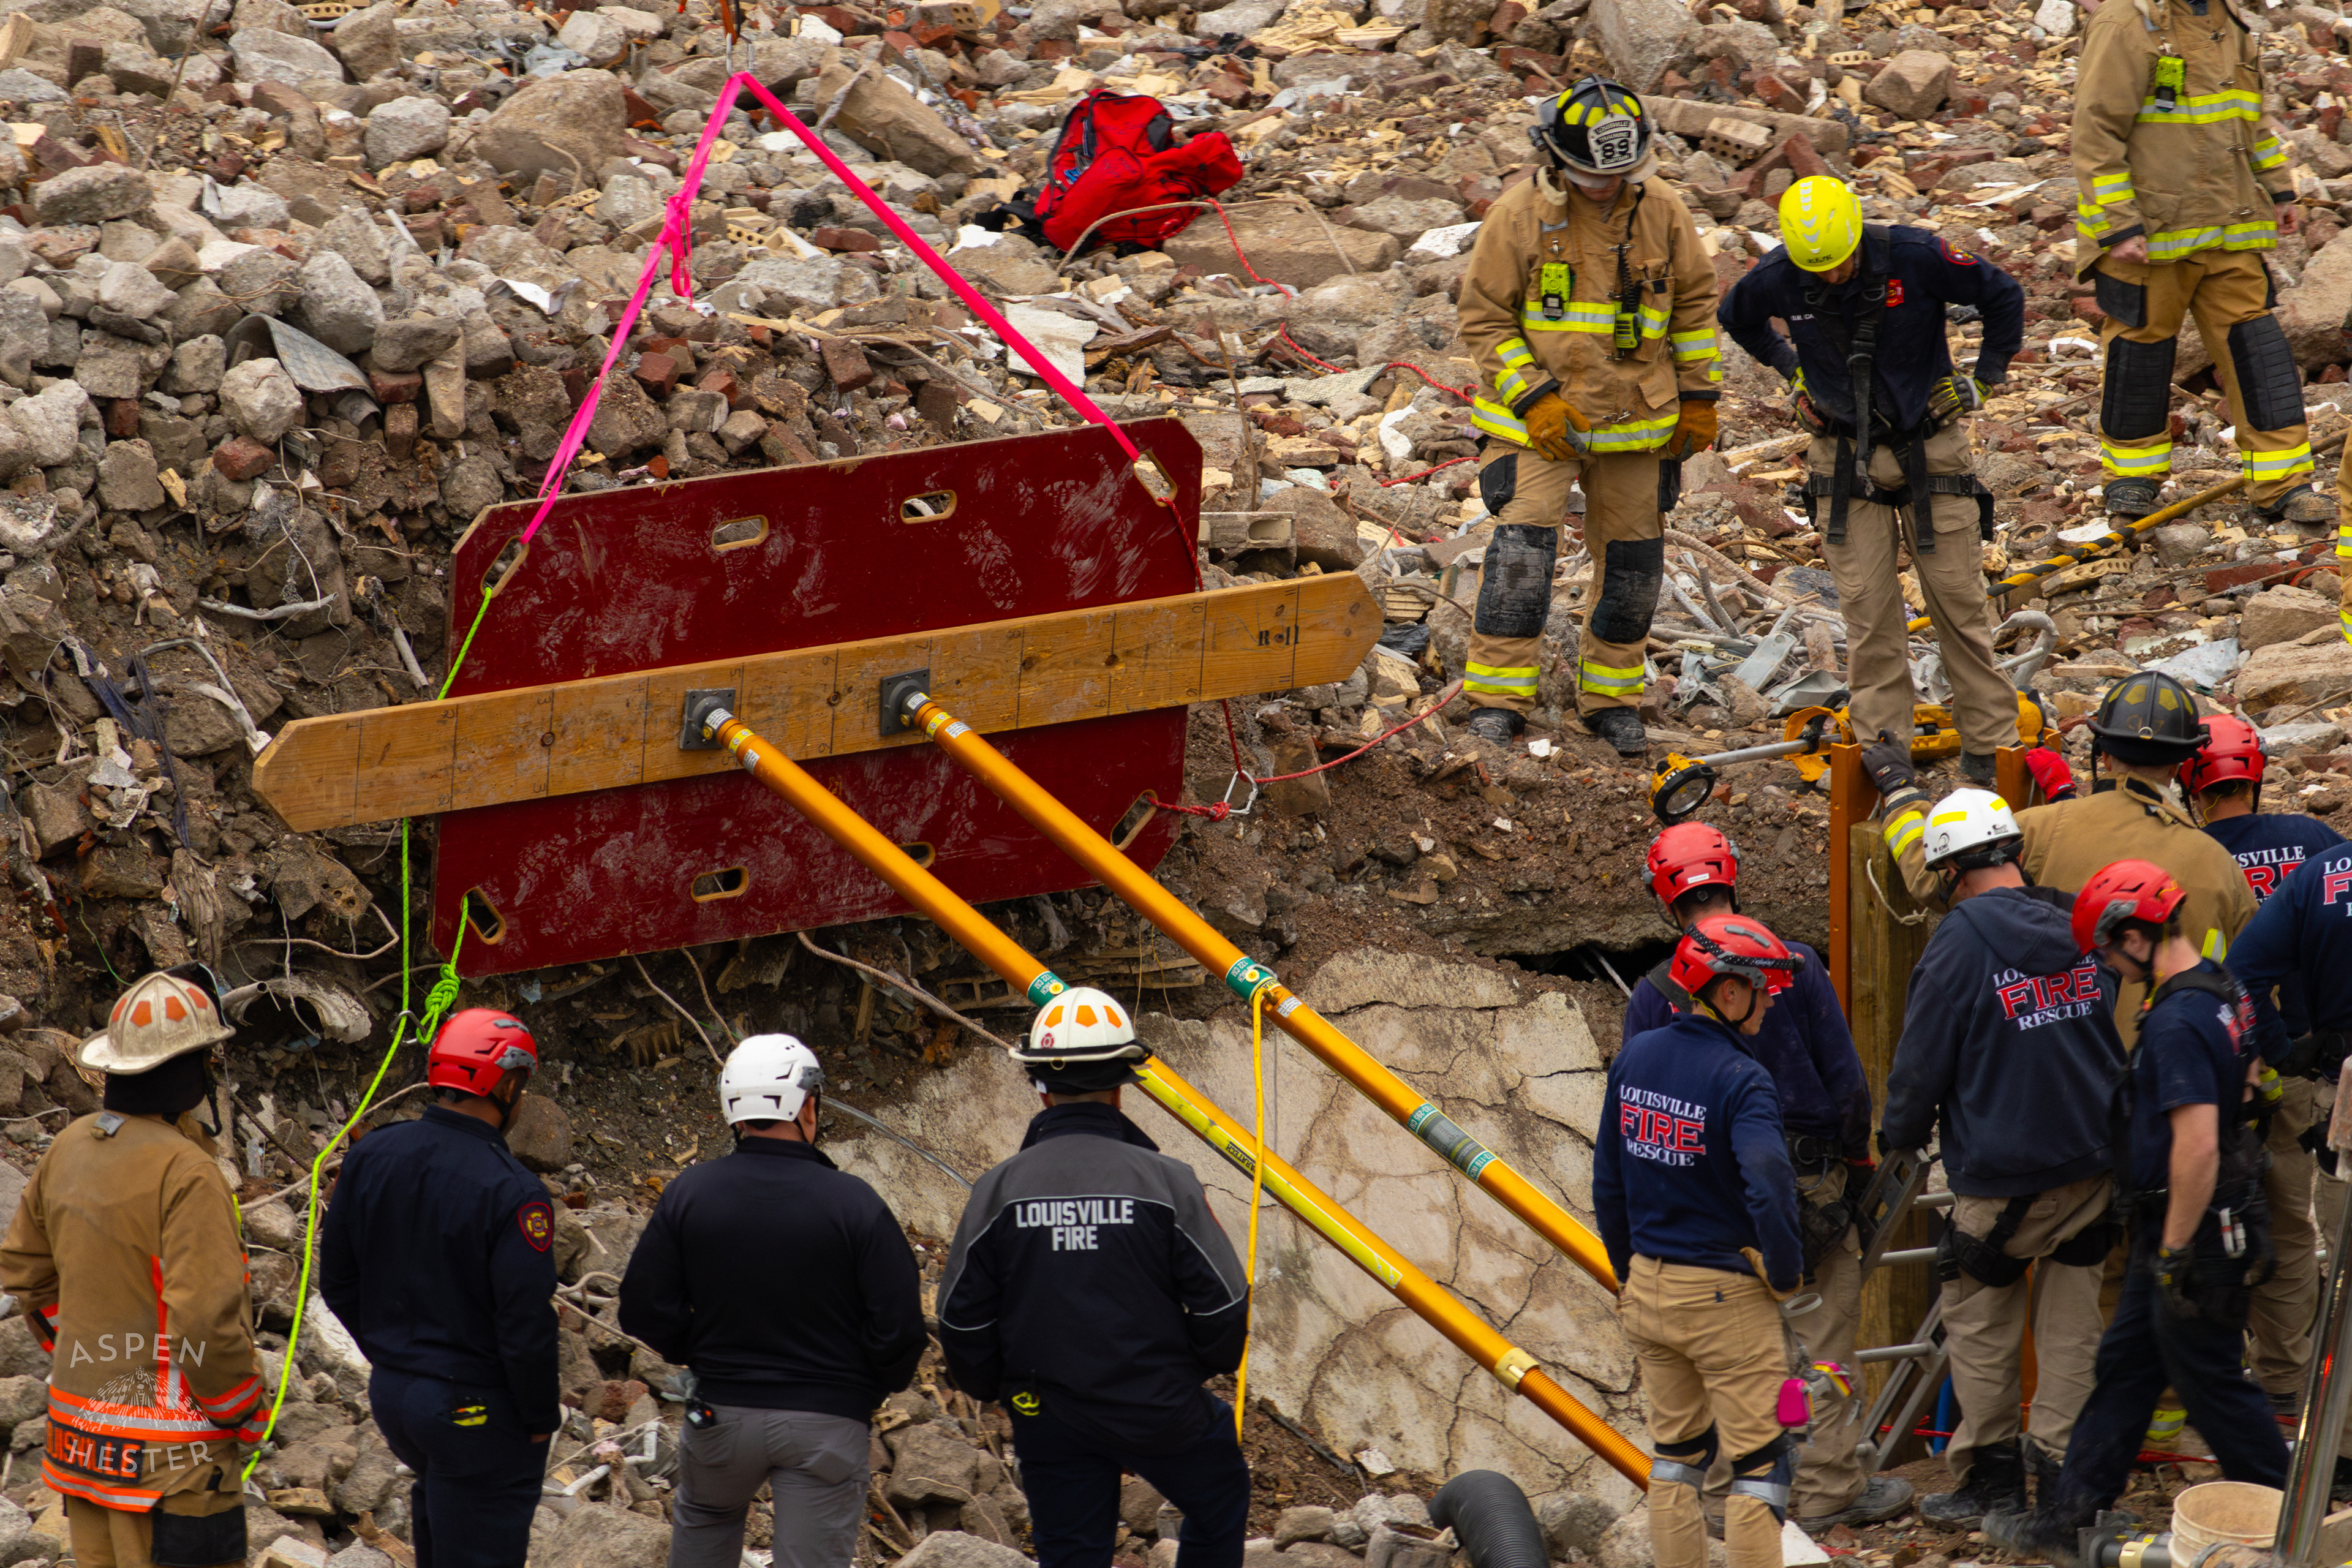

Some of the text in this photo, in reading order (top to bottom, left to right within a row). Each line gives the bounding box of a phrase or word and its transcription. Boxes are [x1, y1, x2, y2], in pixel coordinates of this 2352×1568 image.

[1602, 139, 1629, 159] 89
[1231, 960, 1249, 978] 122 CM
[1033, 979, 1044, 990] CM
[1996, 963, 2101, 1020] FIRE
[2018, 1001, 2092, 1031] RESCUE
[1620, 1084, 1707, 1120] LOUISVILLE
[1620, 1102, 1707, 1155] FIRE
[1225, 1143, 1256, 1173] ARATECH
[1627, 1138, 1695, 1167] RESCUE
[1015, 1199, 1134, 1228] LOUISVILLE
[1052, 1226, 1099, 1252] FIRE
